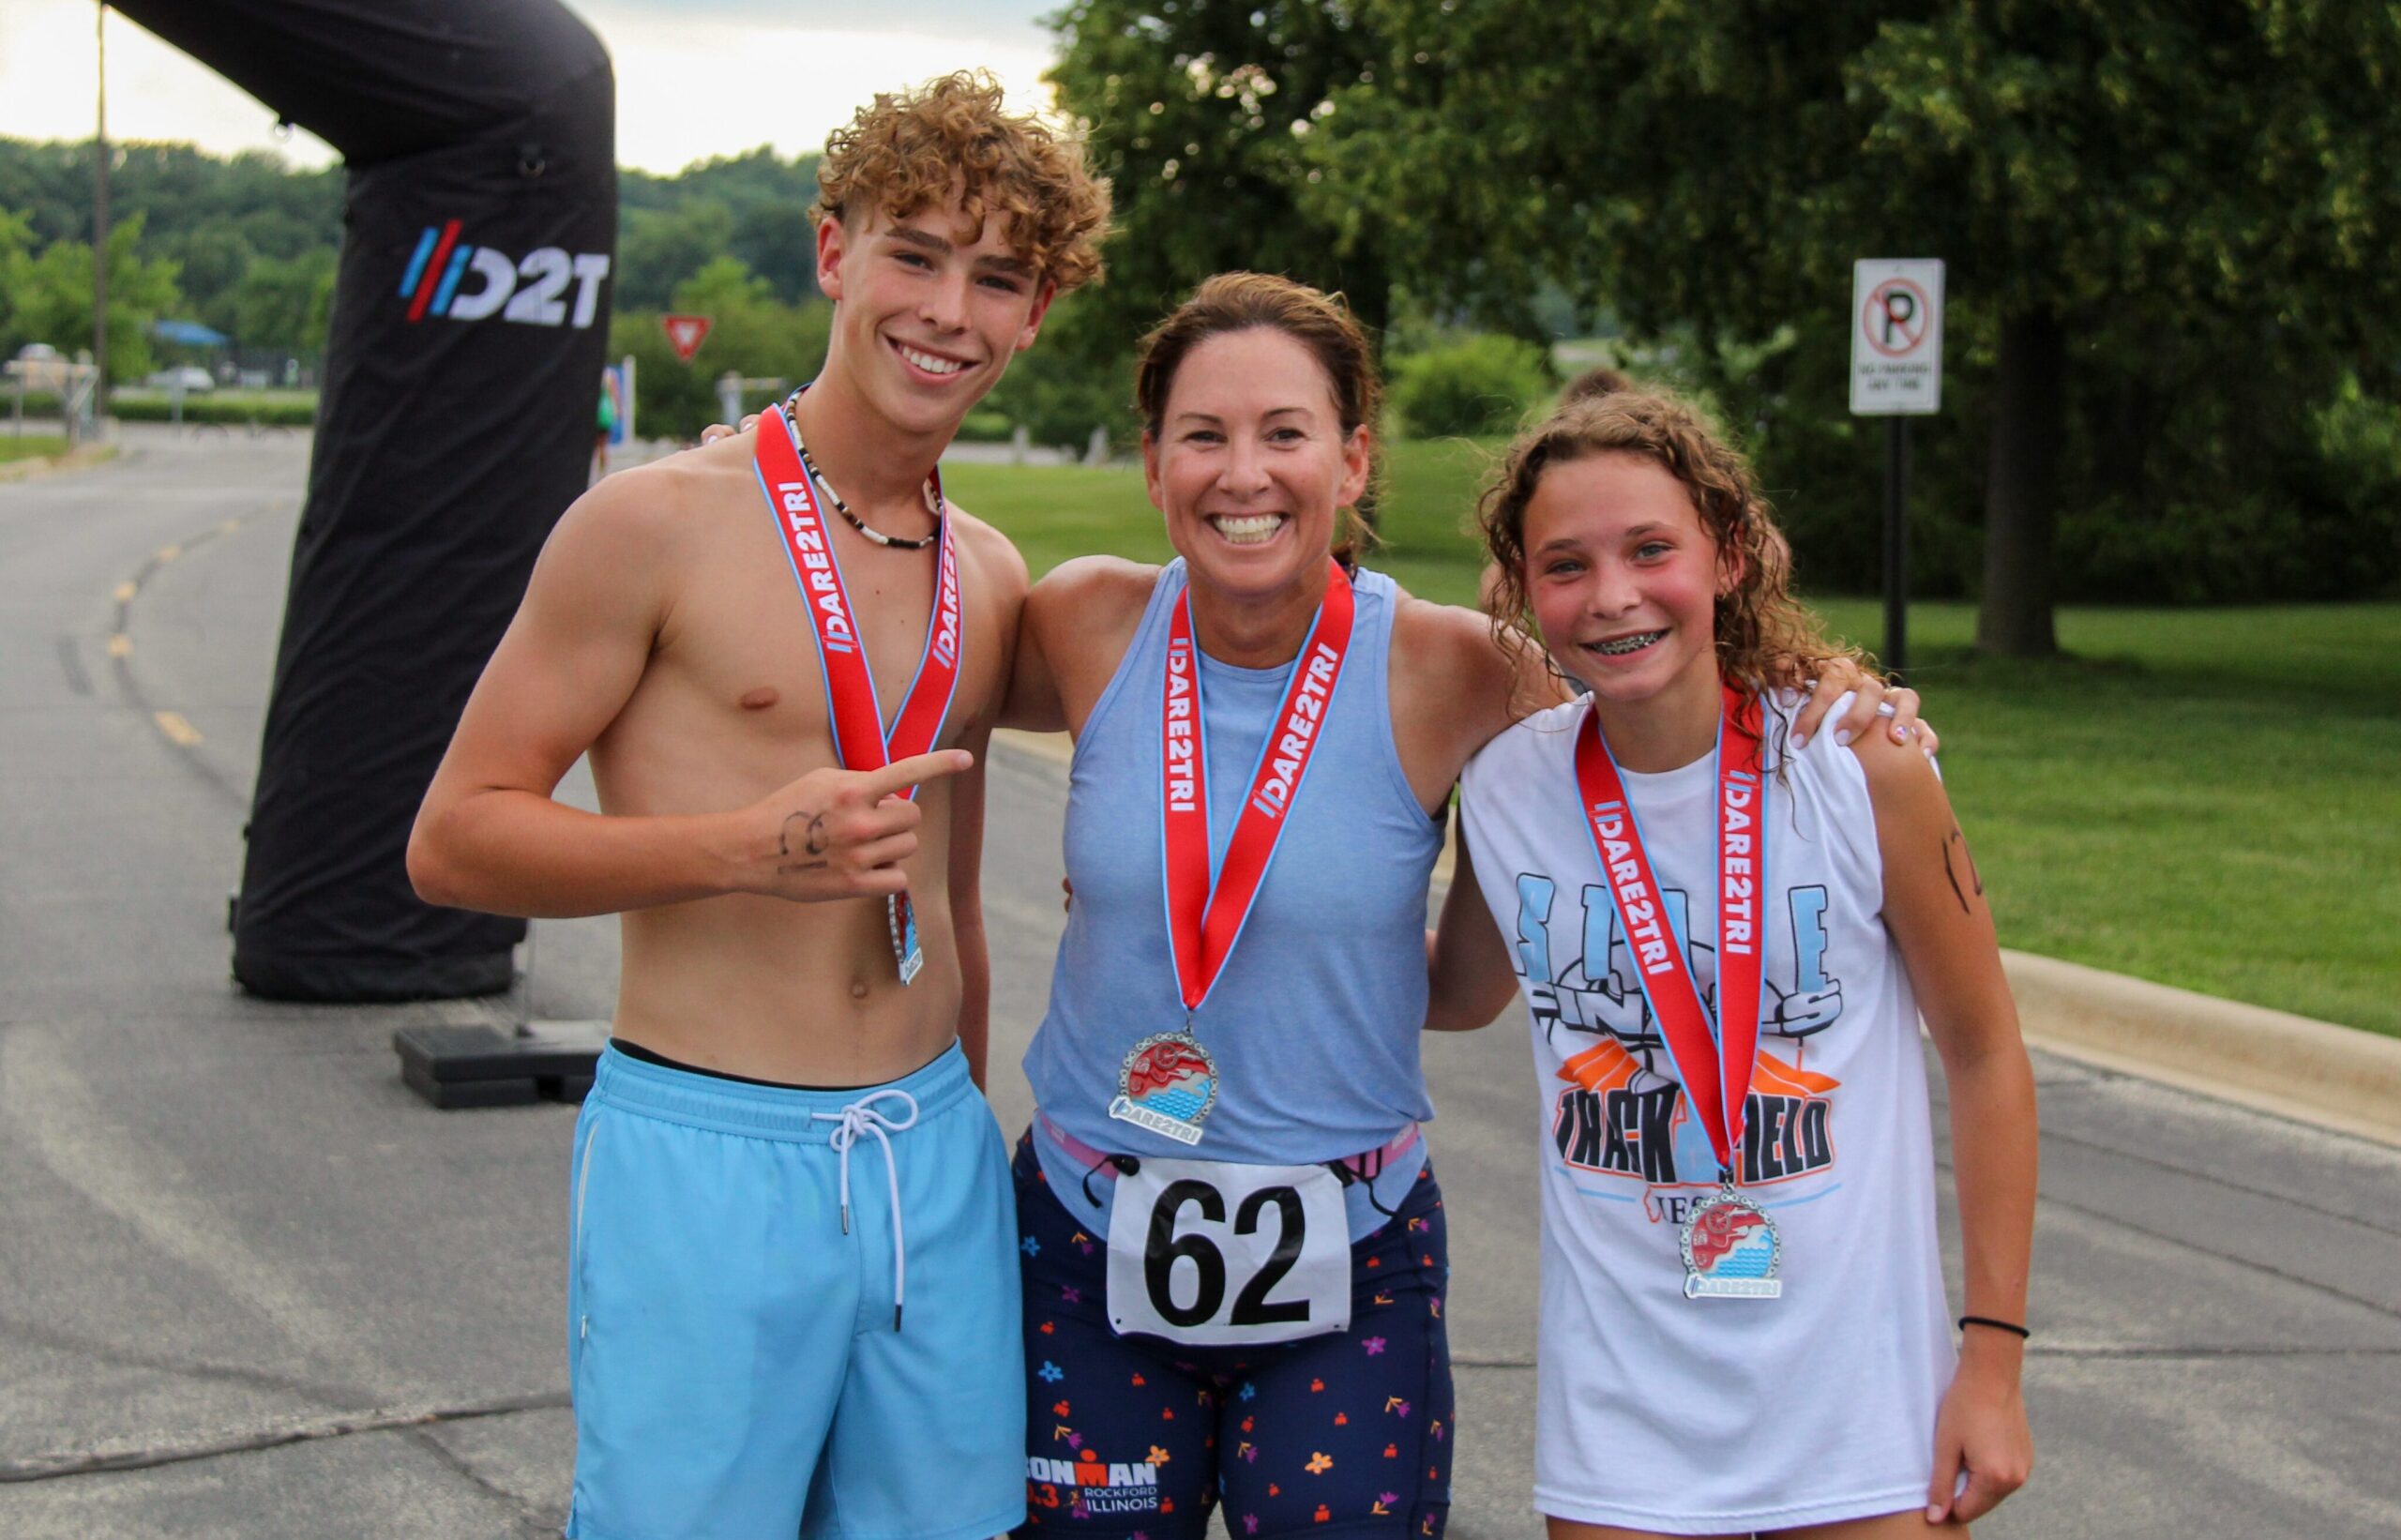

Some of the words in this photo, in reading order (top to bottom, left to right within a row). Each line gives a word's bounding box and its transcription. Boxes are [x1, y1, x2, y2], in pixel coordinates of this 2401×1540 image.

[778, 481, 853, 642] DARE2TRI
[1168, 649, 1196, 812] DARE2TRI
[1261, 642, 1339, 809] DARE2TRI
[1594, 812, 1675, 976] DARE2TRI
[1724, 780, 1754, 956] DARE2TRI
[1144, 1179, 1310, 1328] 62
[1084, 1486, 1157, 1499] ROCKFORD
[1086, 1498, 1158, 1512] ILLINOIS
